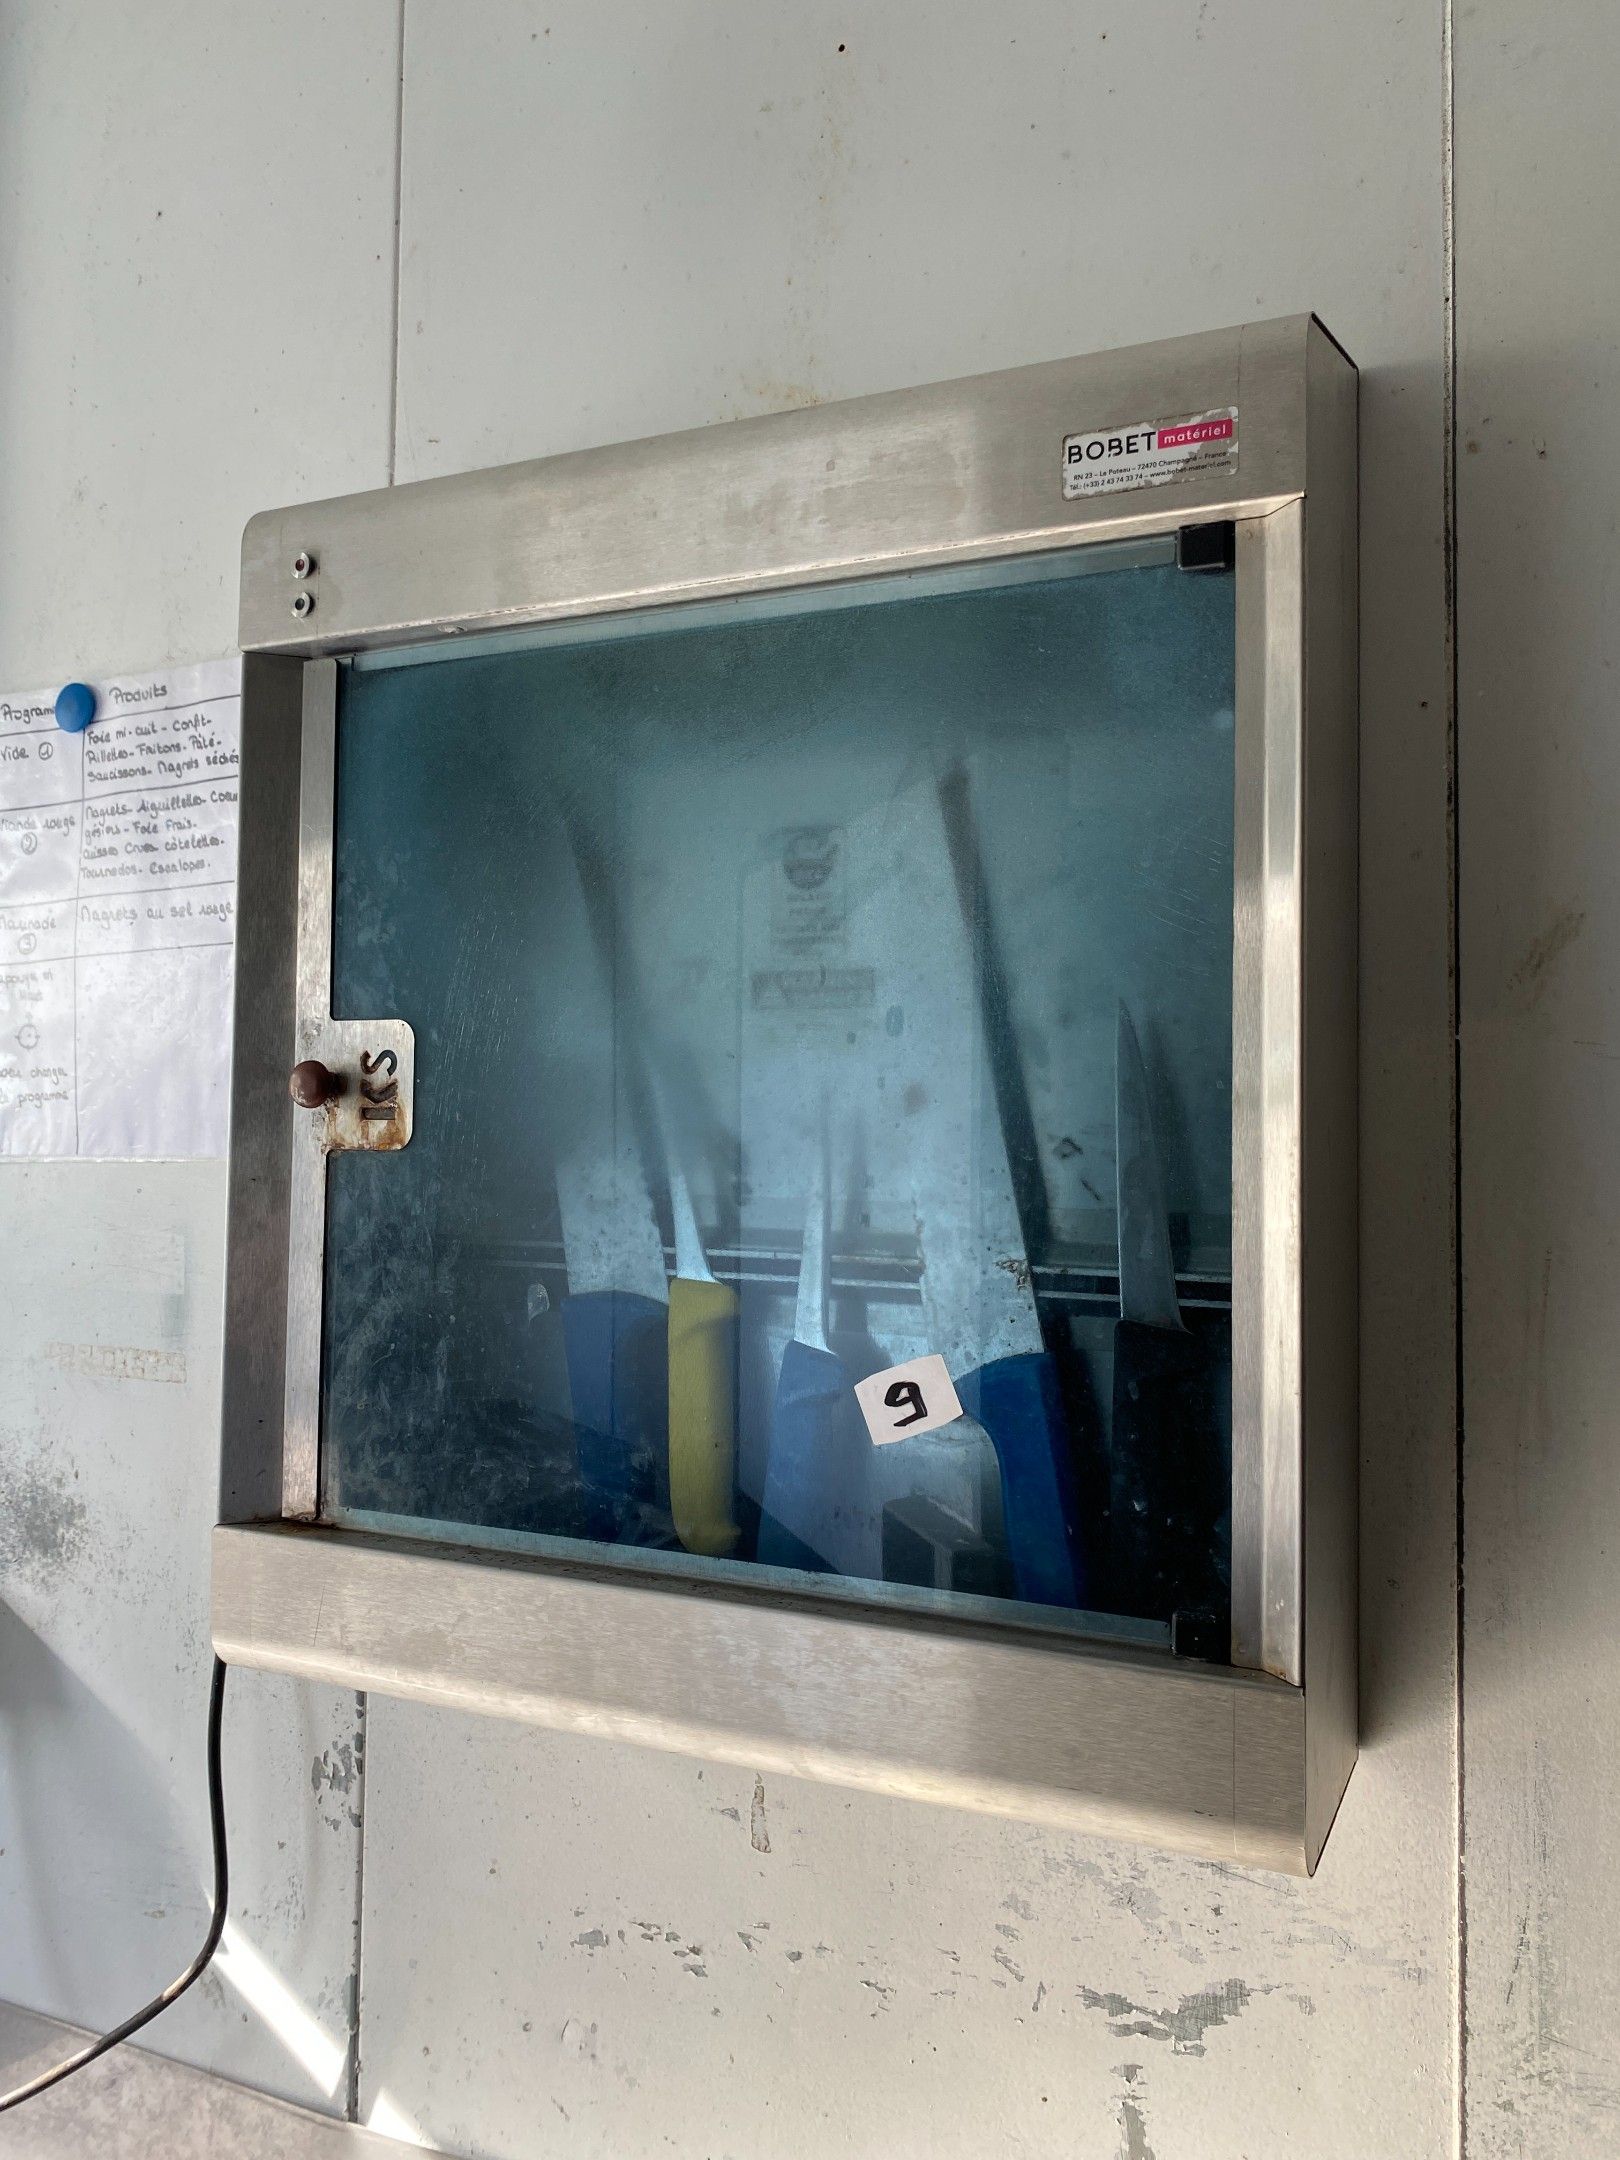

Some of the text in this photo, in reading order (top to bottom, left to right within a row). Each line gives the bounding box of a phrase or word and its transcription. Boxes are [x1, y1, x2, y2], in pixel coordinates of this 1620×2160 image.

[1068, 424, 1226, 464] BOBET matériel
[1085, 472, 1093, 480] 23
[1108, 467, 1131, 476] Poteau
[1137, 461, 1157, 471] 72470
[1204, 450, 1227, 460] France
[1083, 480, 1100, 490] (+33)
[1125, 474, 1134, 482] 33
[108, 683, 168, 704] Produits
[1, 703, 56, 724] Program
[86, 730, 111, 746] Foie
[884, 1381, 928, 1427] 9
